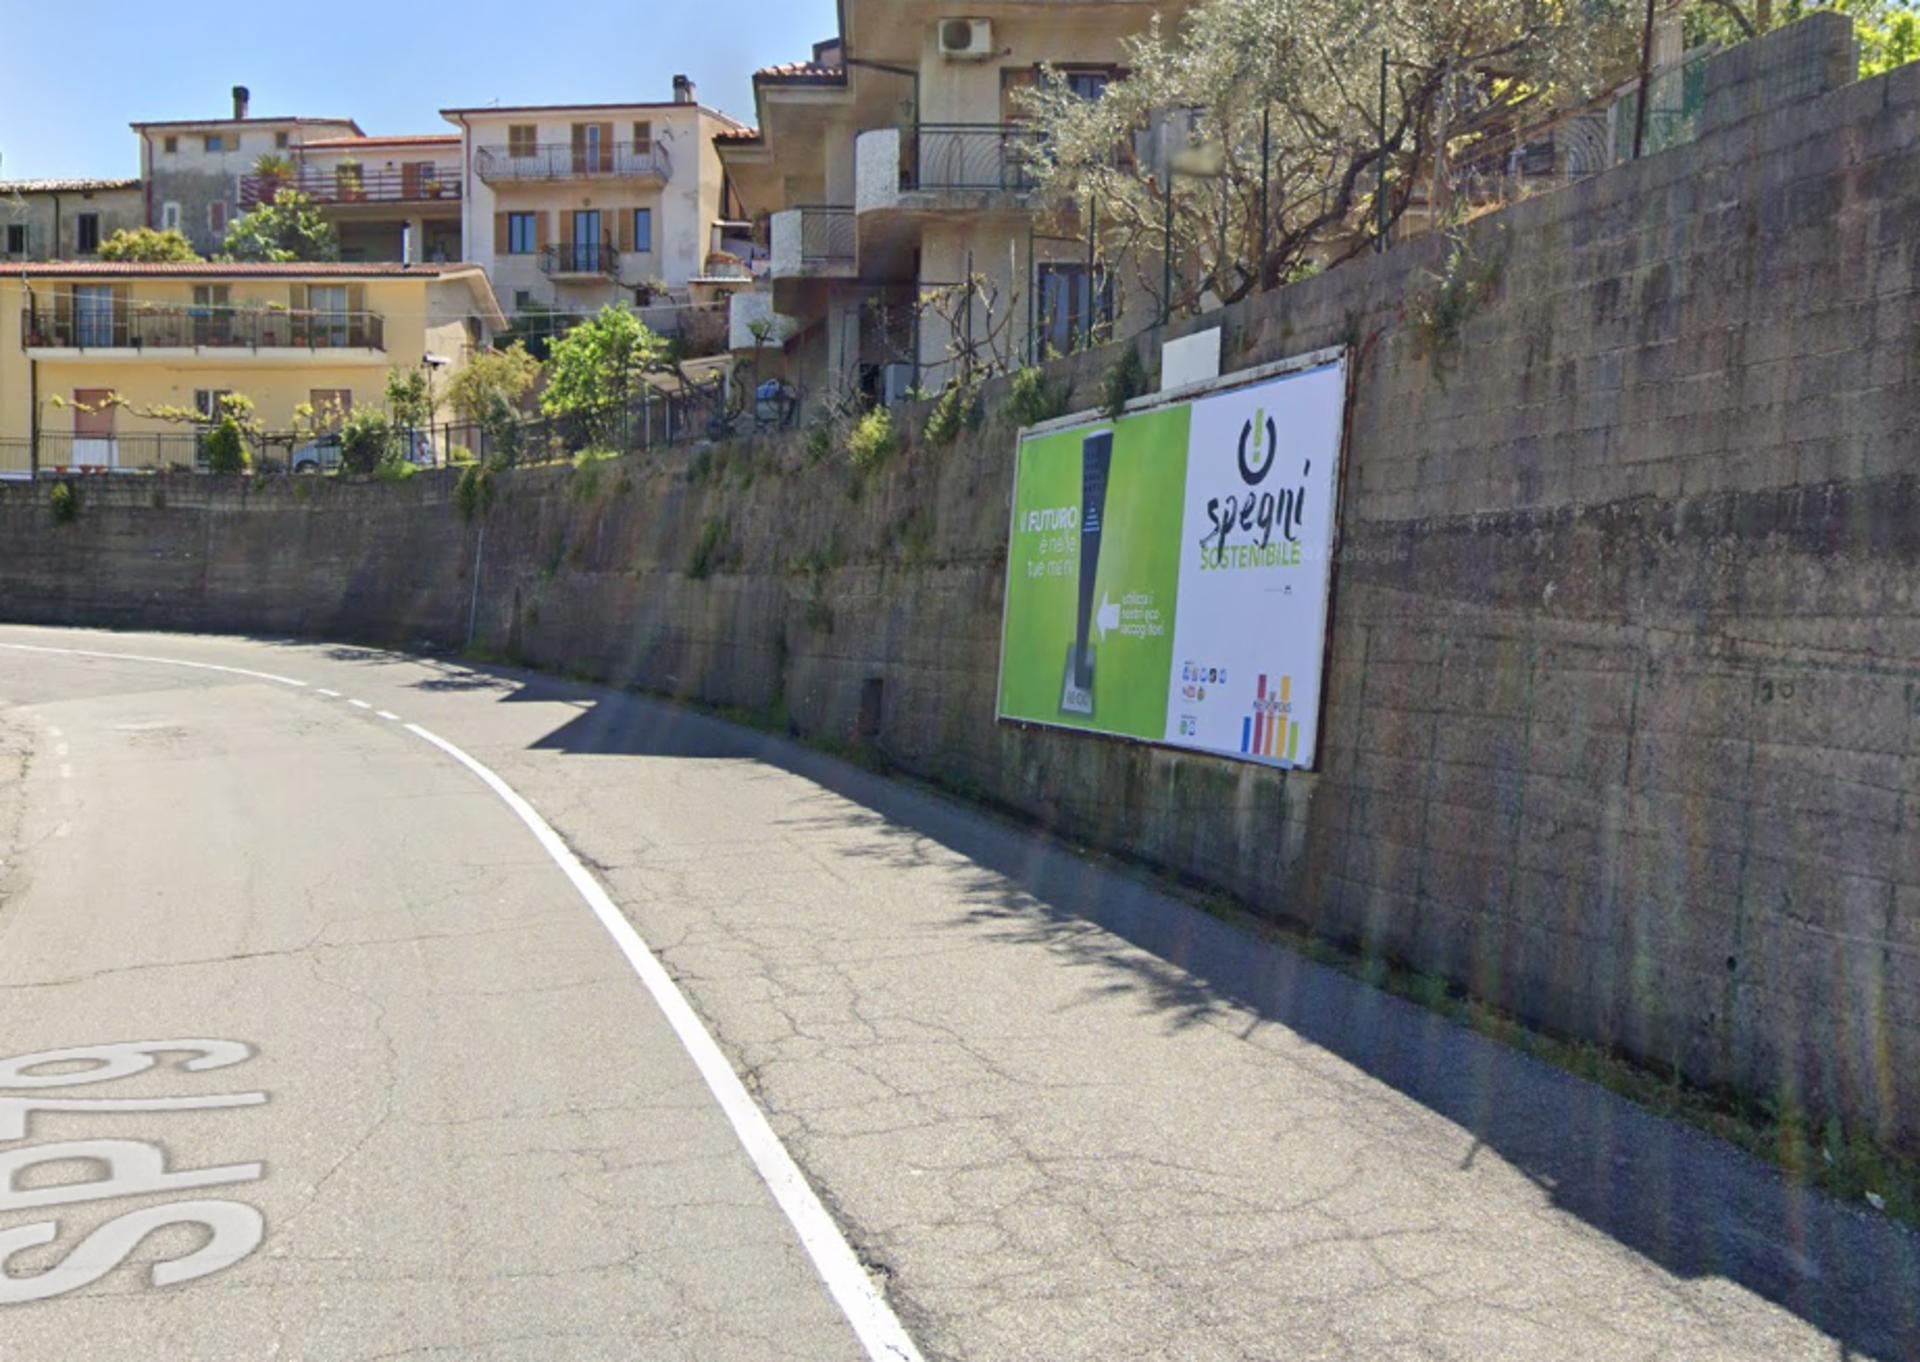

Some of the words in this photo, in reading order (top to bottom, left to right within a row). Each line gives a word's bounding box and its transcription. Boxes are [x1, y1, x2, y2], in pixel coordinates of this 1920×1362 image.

[1028, 505, 1078, 533] FUTURO
[1200, 458, 1310, 564] spegni
[1200, 541, 1301, 571] SOSTENIBILE
